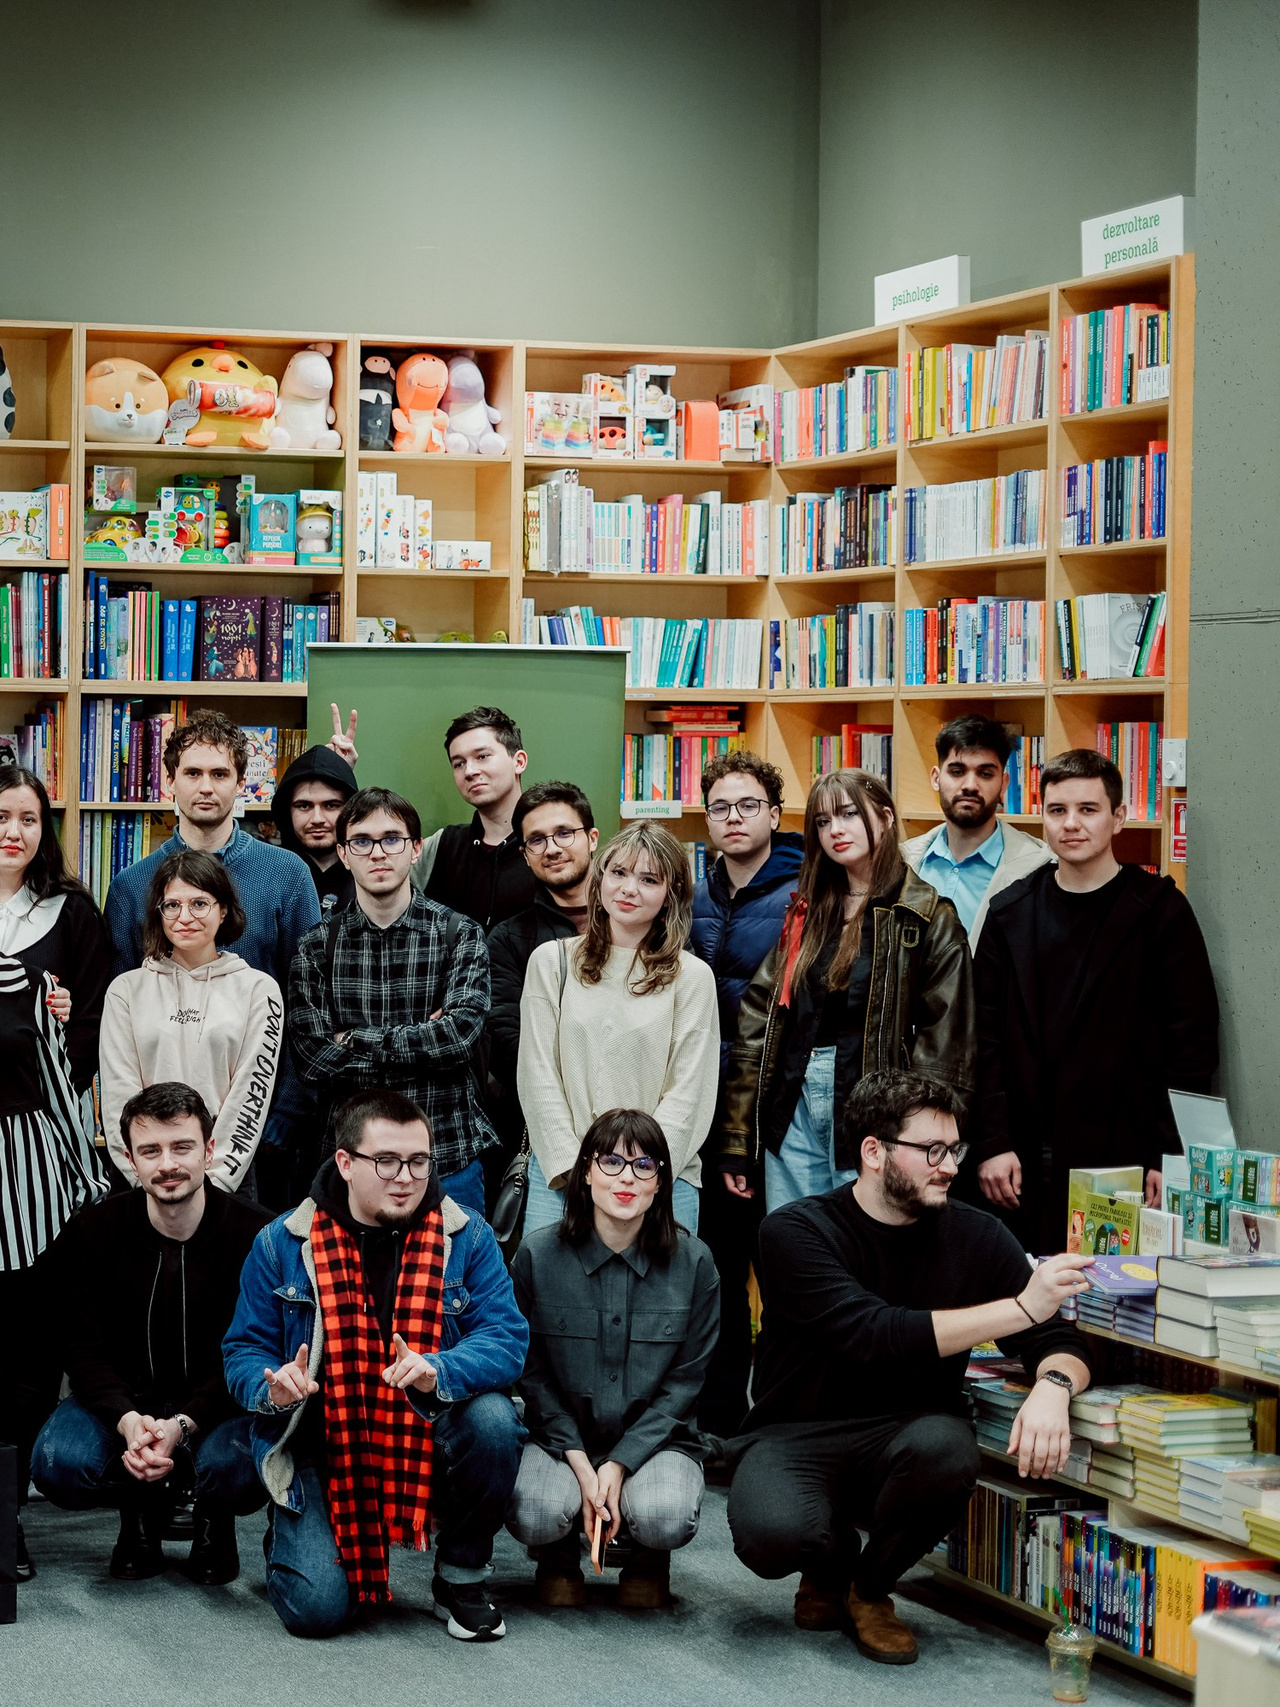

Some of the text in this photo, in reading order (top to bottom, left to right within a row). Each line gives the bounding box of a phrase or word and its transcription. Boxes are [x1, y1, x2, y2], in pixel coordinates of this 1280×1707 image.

[1102, 214, 1160, 240] dezvoltare
[1104, 236, 1159, 269] personală
[892, 283, 939, 311] psihologie
[220, 623, 242, 634] 1001
[222, 996, 282, 1176] DON'T OVERTHINK IT
[1112, 1215, 1132, 1227] FANTASTIC
